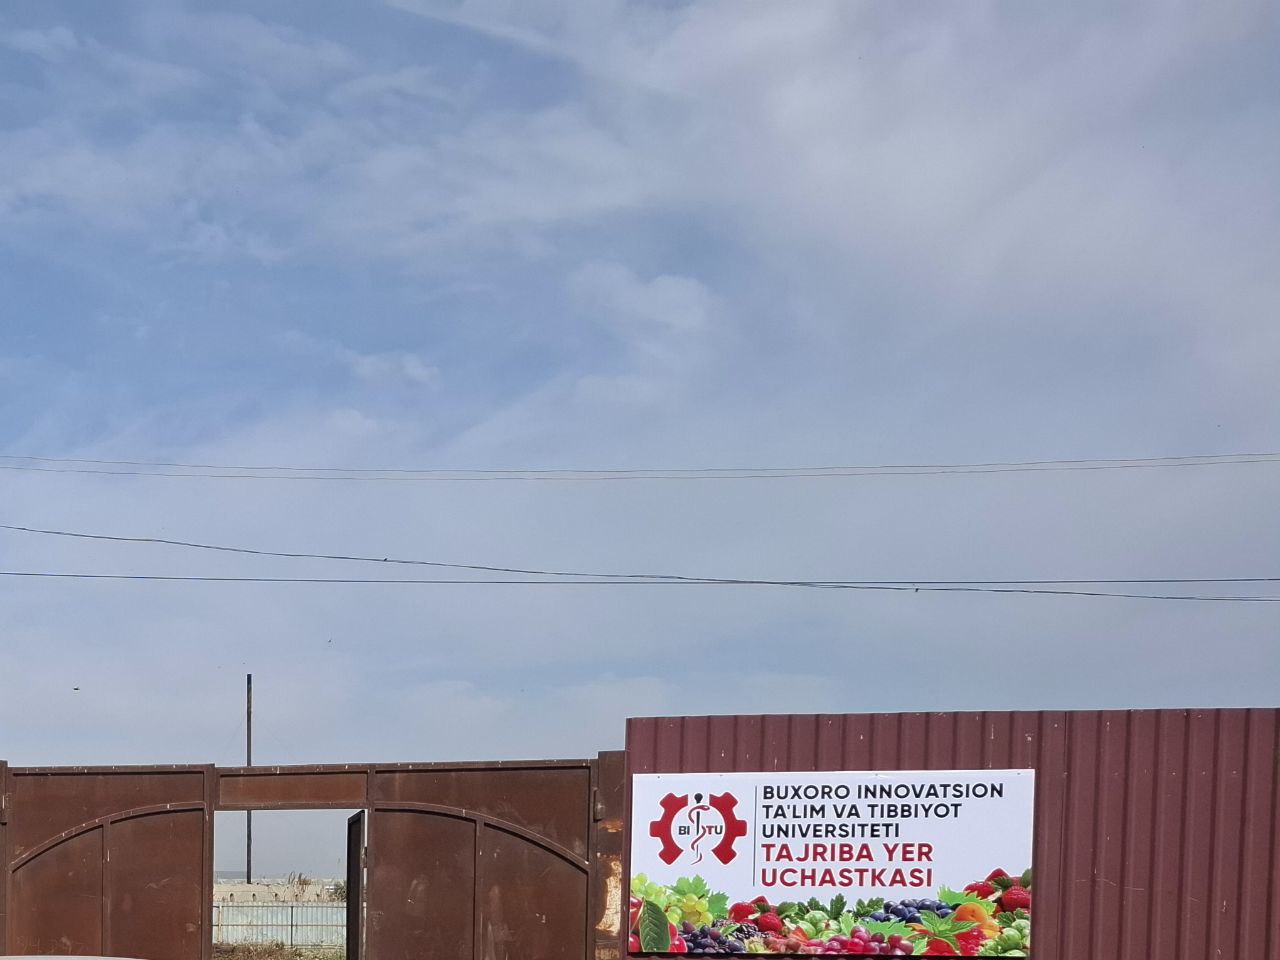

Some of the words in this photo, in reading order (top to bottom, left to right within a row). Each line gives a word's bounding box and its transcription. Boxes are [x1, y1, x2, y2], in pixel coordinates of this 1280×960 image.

[763, 784, 850, 800] BUXORO
[857, 783, 1004, 799] INNOVATSION
[762, 804, 826, 819] TA'LIM
[833, 804, 861, 819] VA
[867, 803, 962, 818] TIBBIYOT
[762, 823, 900, 838] UNIVERSITETI
[761, 843, 874, 862] TAJRIBA
[883, 843, 933, 862] YER
[761, 868, 933, 887] UCHASTKASI
